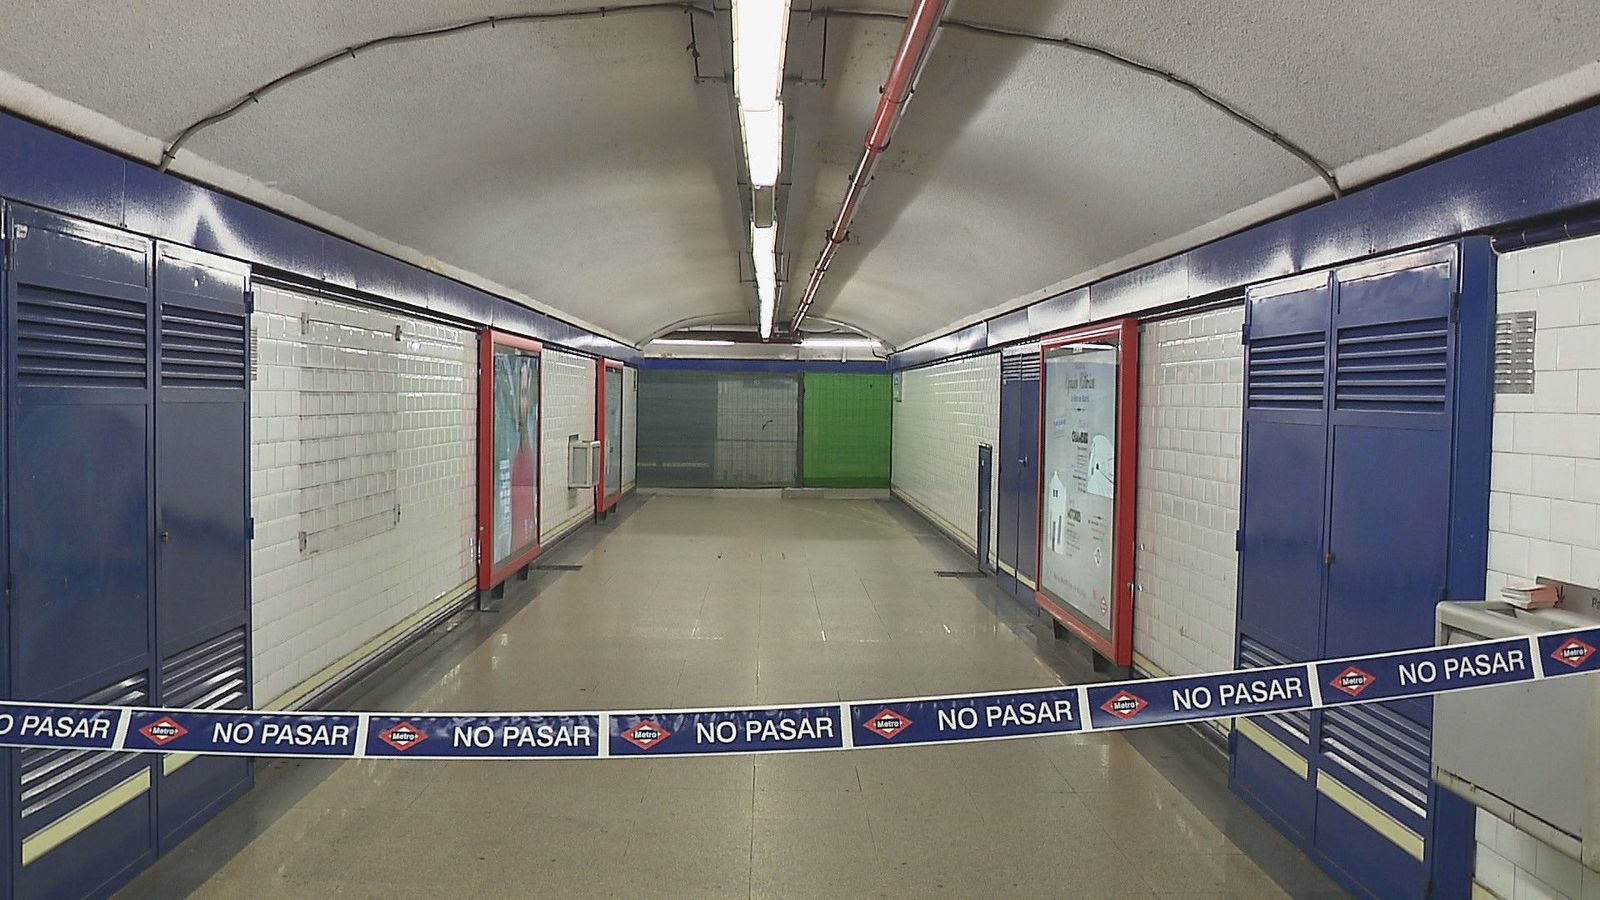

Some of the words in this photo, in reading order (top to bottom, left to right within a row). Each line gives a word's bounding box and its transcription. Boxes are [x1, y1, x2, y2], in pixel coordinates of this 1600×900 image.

[1562, 648, 1584, 658] Metro
[1398, 661, 1437, 686] NO
[1443, 649, 1525, 680] PASAR
[1341, 675, 1364, 686] Metro
[1172, 686, 1212, 711] NO
[1219, 677, 1303, 706] PASAR
[1113, 700, 1136, 710] Metro
[876, 718, 900, 729] Metro
[938, 707, 978, 731] NO
[986, 700, 1073, 728] PASAR
[0, 714, 14, 735] O
[20, 715, 111, 739] PASAR
[151, 725, 176, 736] Metro
[212, 722, 254, 744] NO
[261, 723, 350, 747] PASAR
[633, 728, 658, 739] Metro
[696, 721, 737, 744] NO
[745, 717, 834, 742] PASAR
[391, 731, 416, 742] Metro
[453, 725, 495, 748] NO
[502, 725, 591, 748] PASAR
